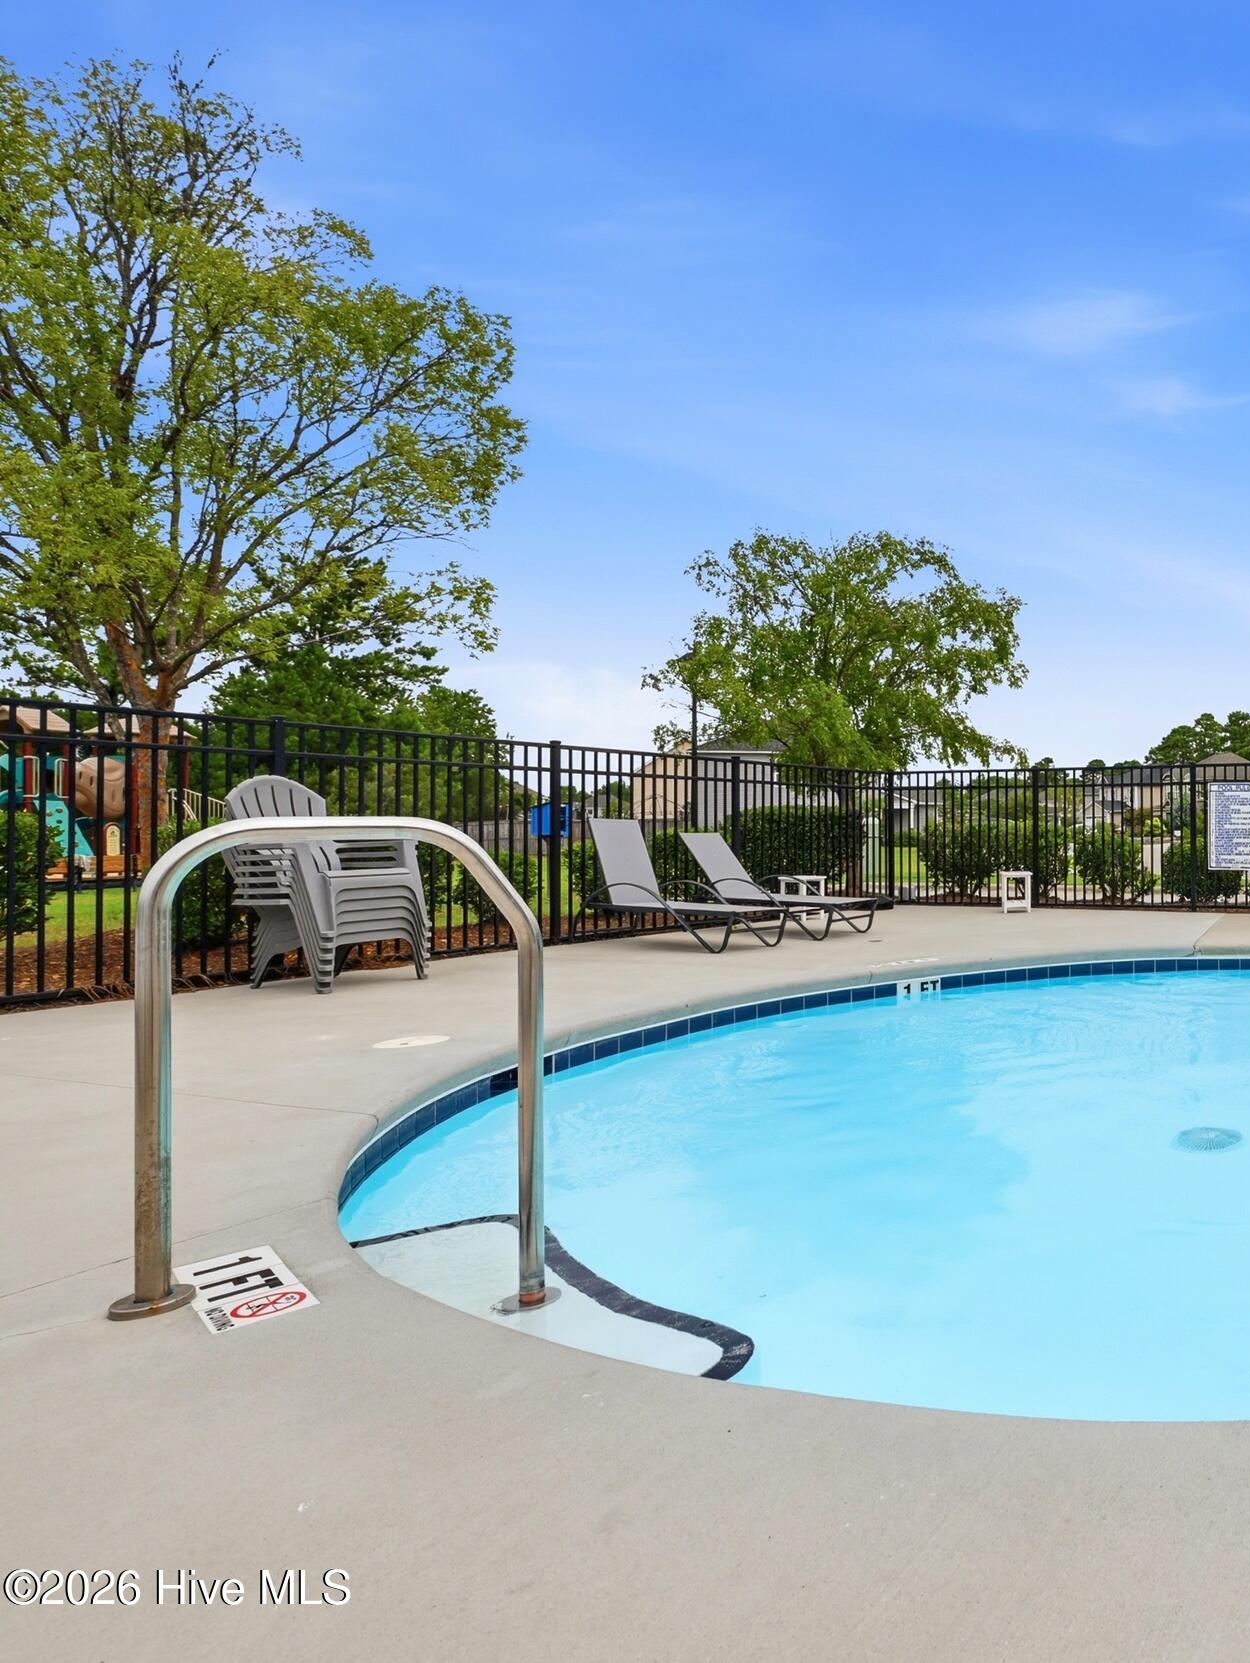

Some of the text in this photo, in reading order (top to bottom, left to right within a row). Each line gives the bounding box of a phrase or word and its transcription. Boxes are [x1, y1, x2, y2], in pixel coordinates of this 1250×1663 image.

[903, 983, 911, 993] 1
[193, 1256, 284, 1303] 1 FT
